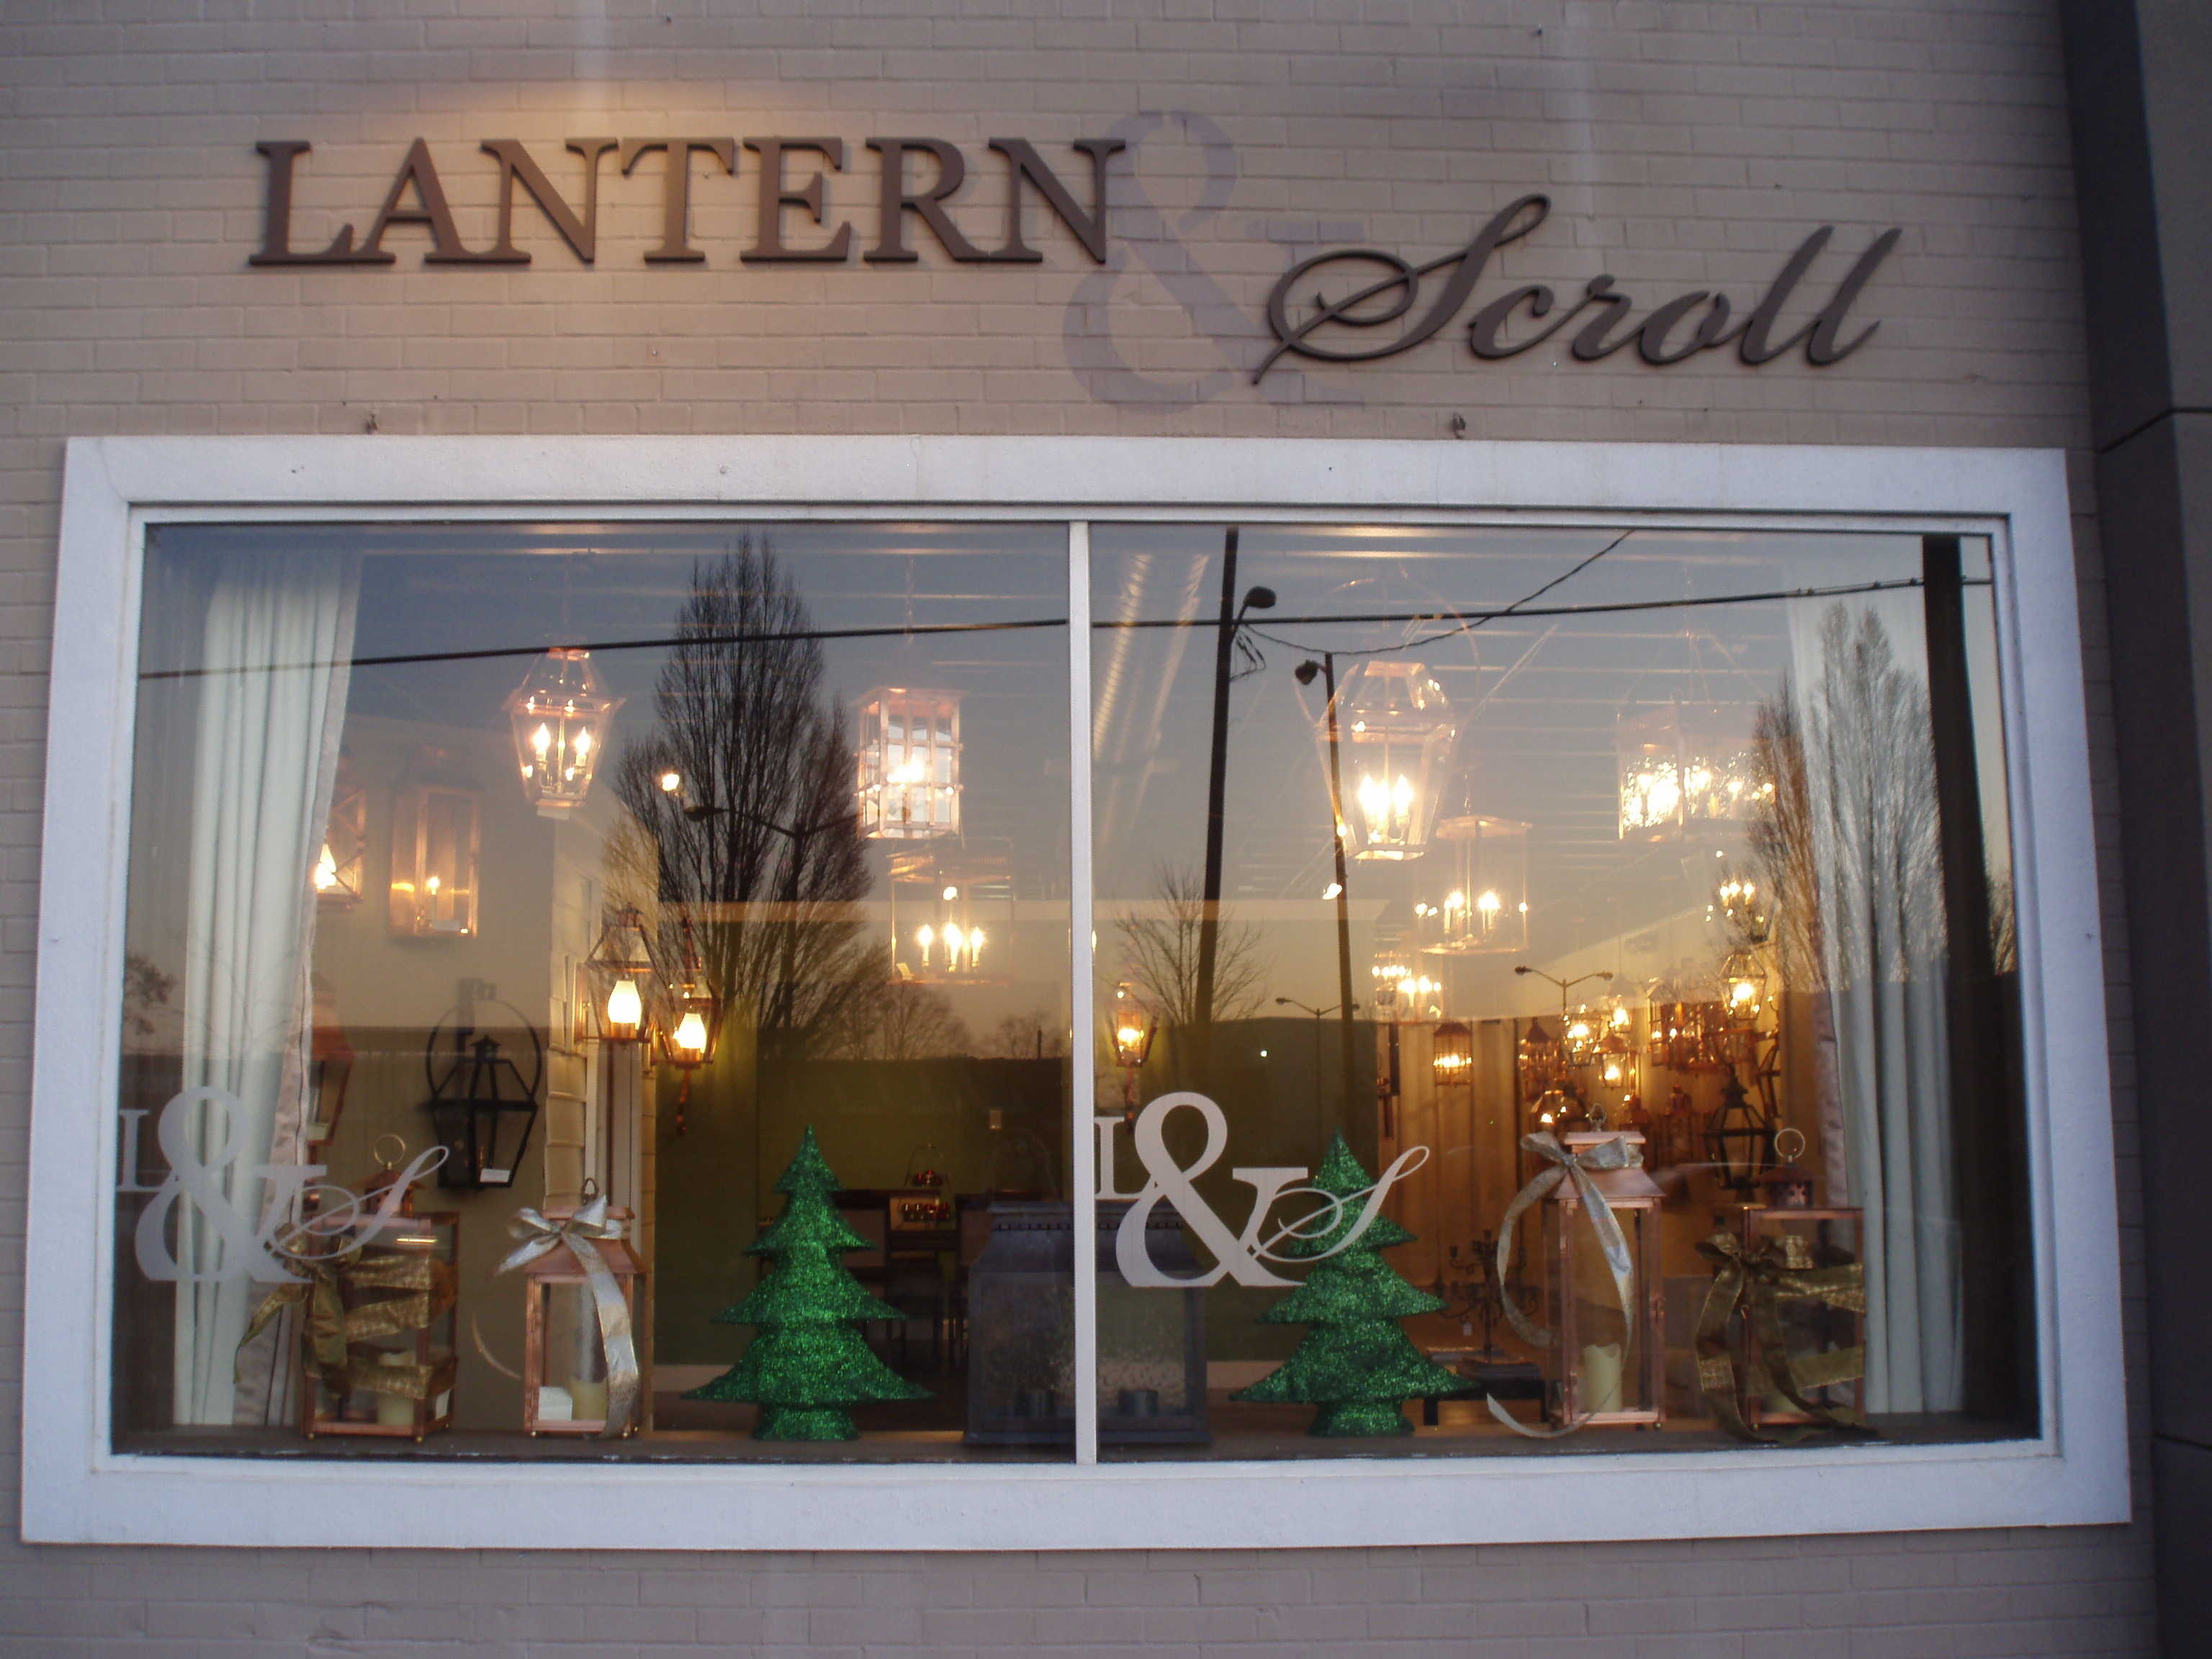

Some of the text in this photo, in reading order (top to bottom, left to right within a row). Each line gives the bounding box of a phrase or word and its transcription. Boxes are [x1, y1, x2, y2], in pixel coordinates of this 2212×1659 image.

[248, 109, 1903, 414] LANTERN & Scroll
